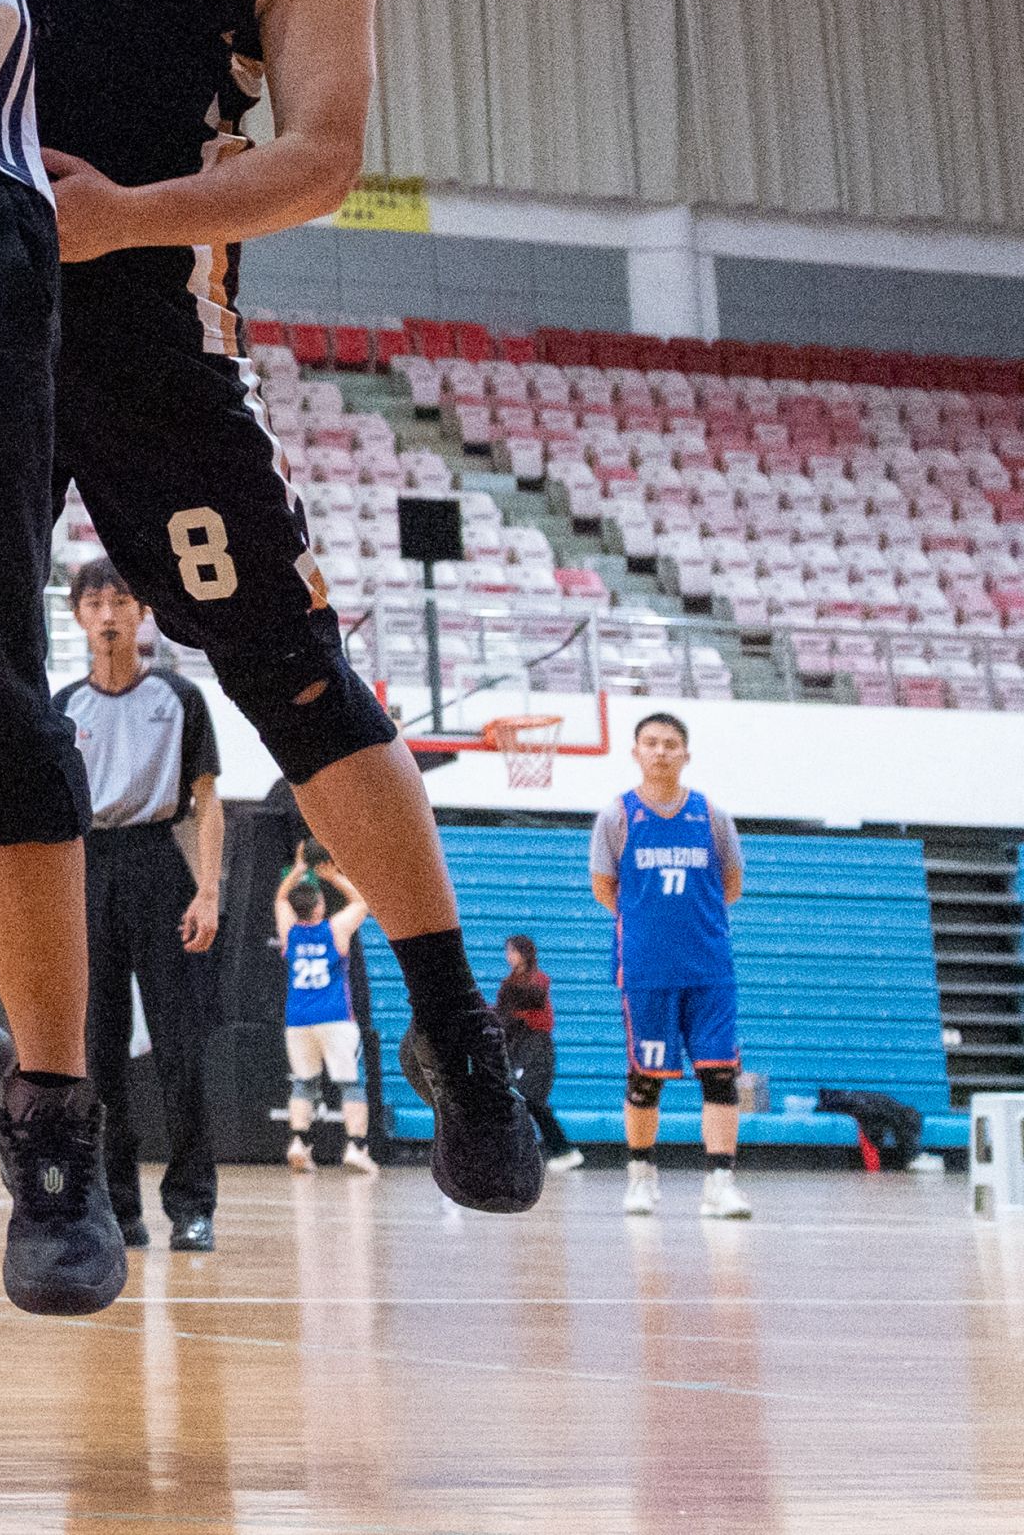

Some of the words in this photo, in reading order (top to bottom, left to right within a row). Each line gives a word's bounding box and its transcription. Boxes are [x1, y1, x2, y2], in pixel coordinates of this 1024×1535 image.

[167, 506, 238, 601] 8
[659, 868, 686, 895] 77
[639, 1040, 666, 1067] 77
